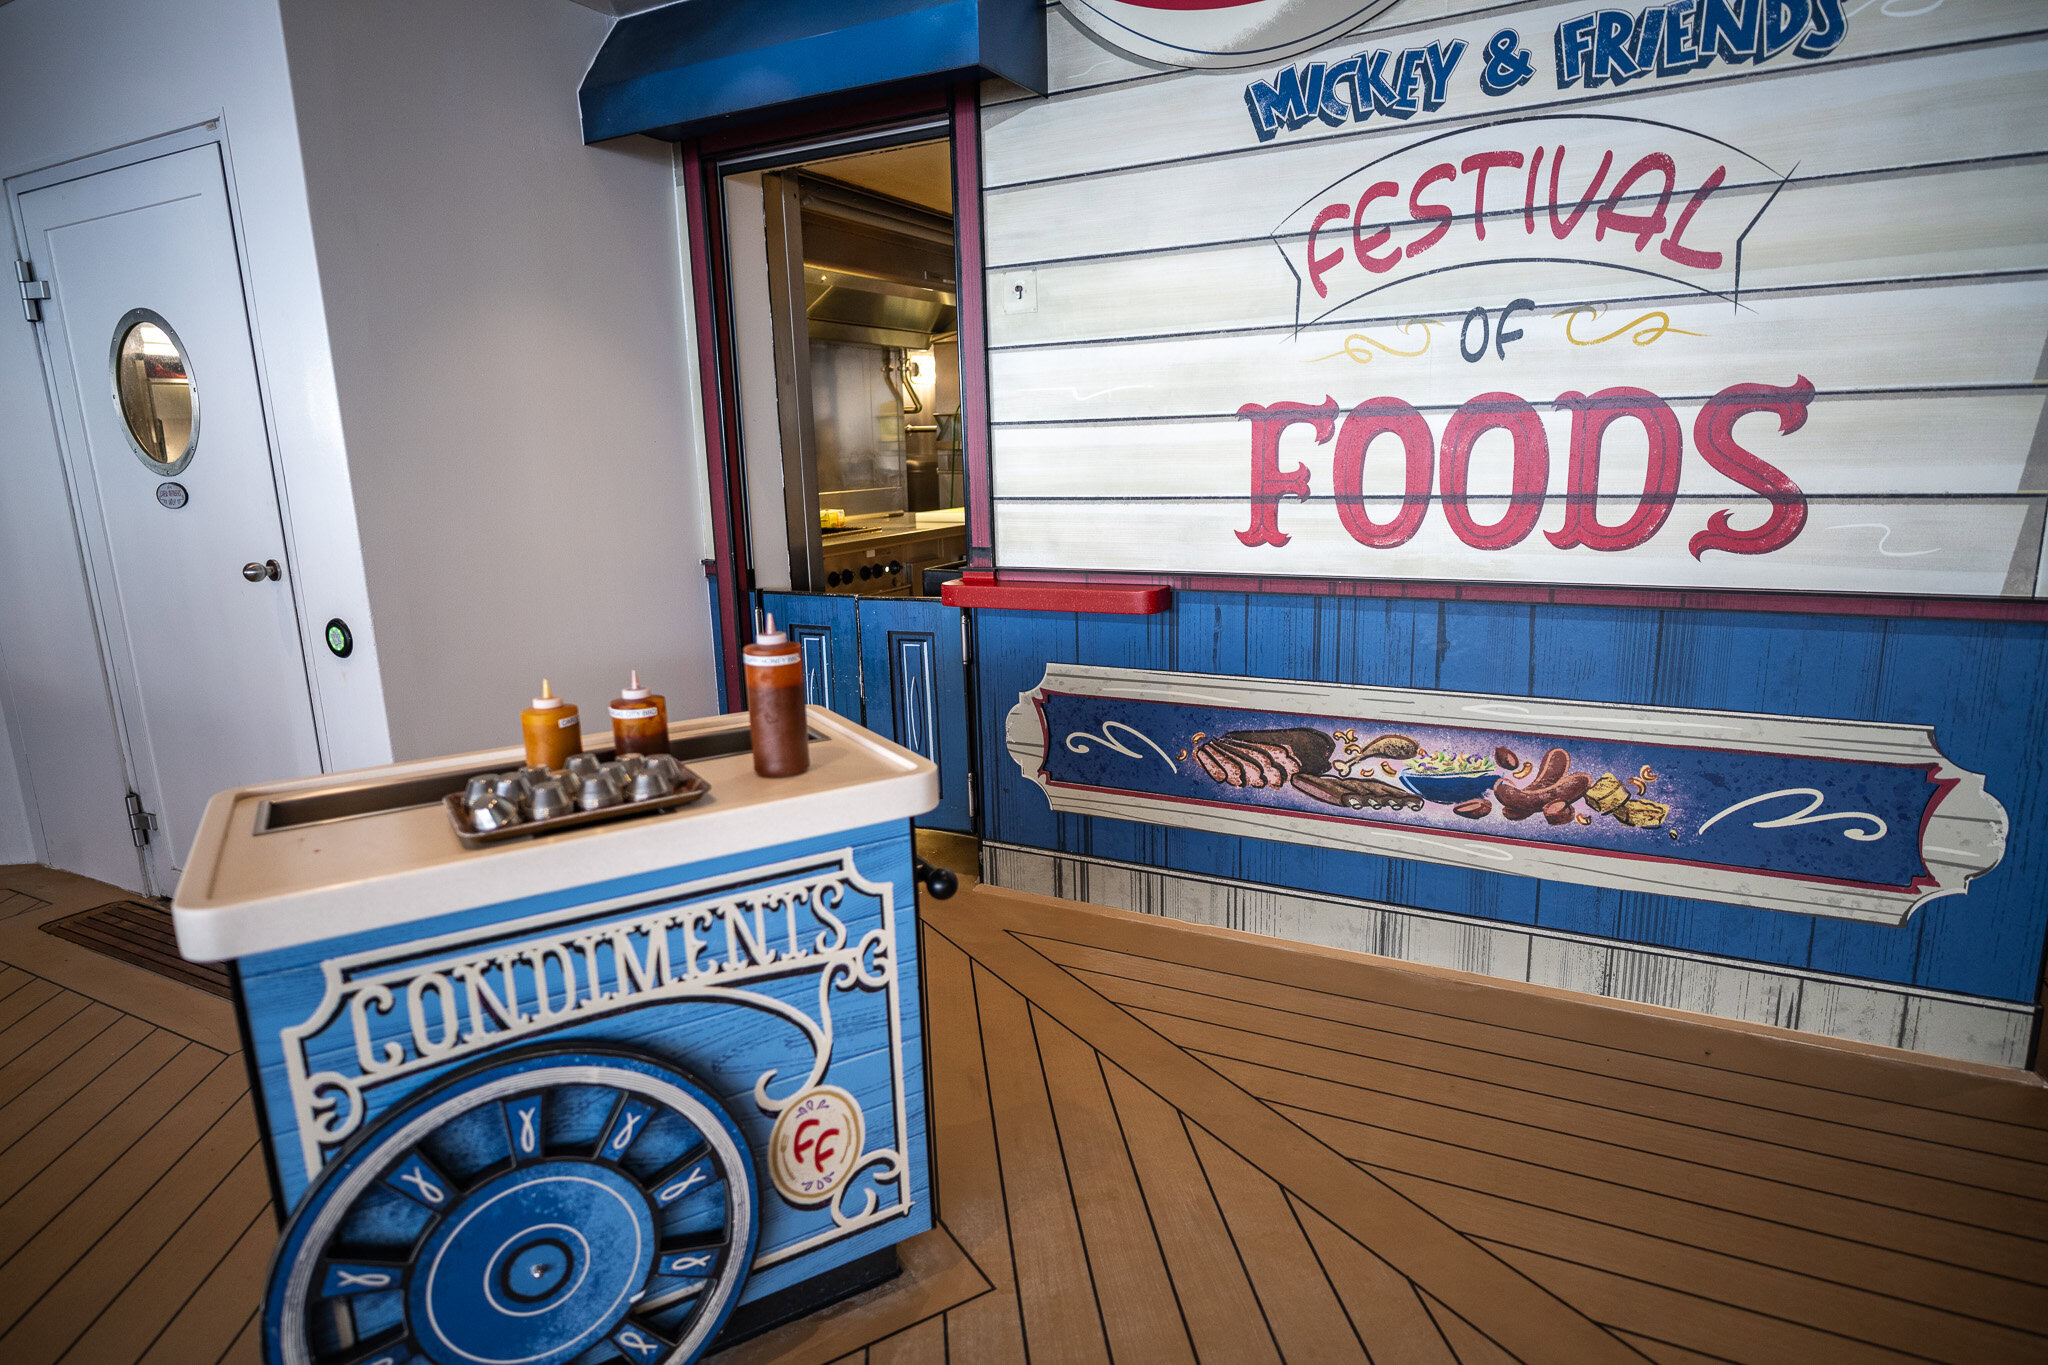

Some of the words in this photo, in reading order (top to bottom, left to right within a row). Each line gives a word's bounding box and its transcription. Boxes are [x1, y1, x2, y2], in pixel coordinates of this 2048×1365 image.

[1244, 38, 1468, 141] MICKEY
[1480, 27, 1536, 96] &
[1555, 0, 1849, 89] FRIENDS
[1307, 144, 1726, 298] FESTIVAL
[1460, 297, 1536, 363] OF
[1235, 374, 1817, 563] FOODS
[348, 880, 849, 1077] CONDIMENTS
[793, 1118, 840, 1173] FF
